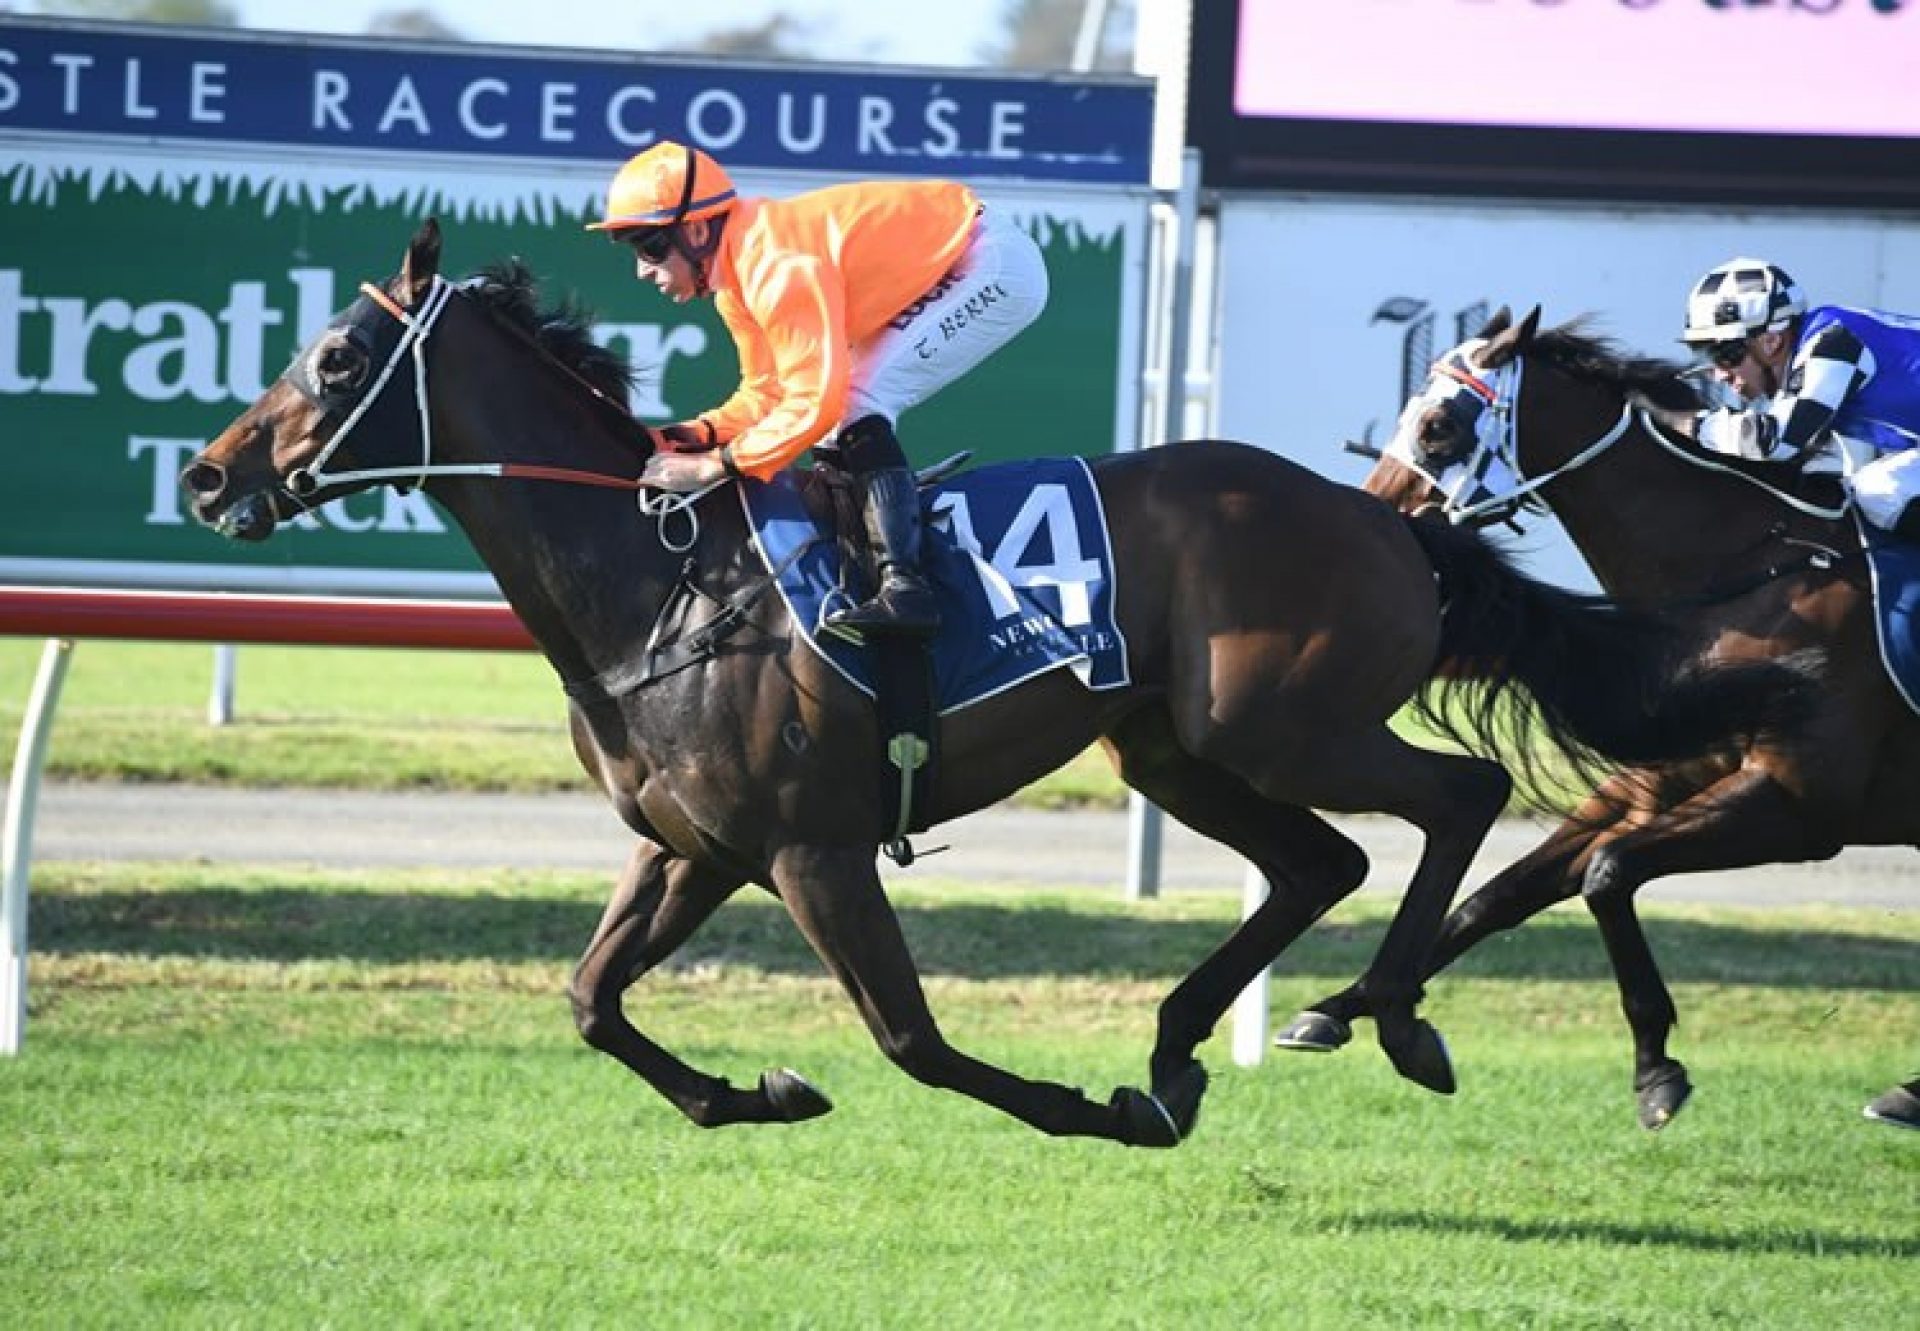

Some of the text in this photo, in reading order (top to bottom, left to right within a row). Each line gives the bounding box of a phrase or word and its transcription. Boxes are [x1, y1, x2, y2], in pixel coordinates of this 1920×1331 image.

[0, 49, 1027, 157] STLE RACECOURSE
[931, 483, 1103, 627] 14
